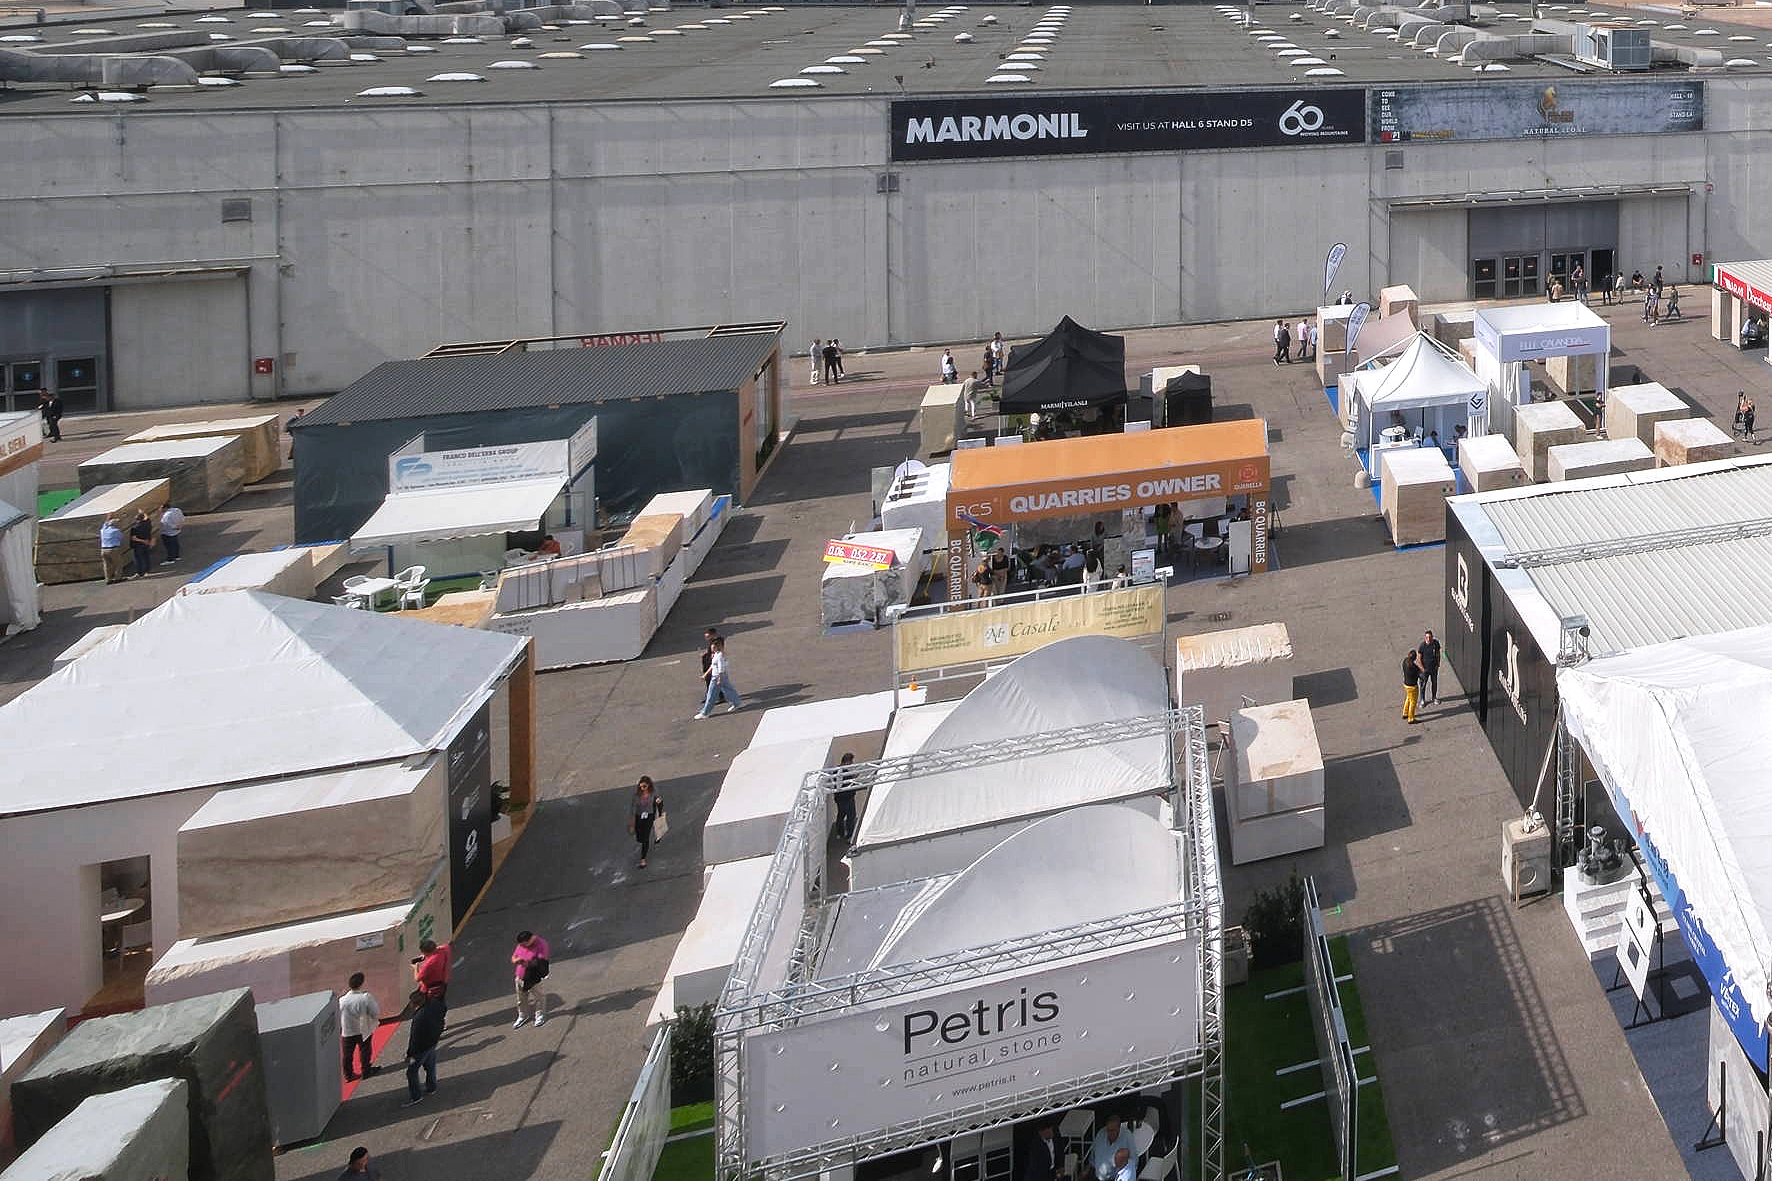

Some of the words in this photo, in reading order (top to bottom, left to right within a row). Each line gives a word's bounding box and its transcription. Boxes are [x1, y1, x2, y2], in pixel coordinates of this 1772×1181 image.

[906, 113, 1088, 144] MARMONIL
[1117, 122, 1141, 131] VISIT
[1143, 121, 1157, 130] US
[1158, 121, 1171, 130] AT
[1172, 120, 1197, 129] HALL
[1198, 120, 1205, 129] 6
[1206, 119, 1238, 128] STAND
[1240, 119, 1253, 127] D5
[1279, 100, 1324, 136] 60
[955, 502, 992, 519] BCS
[1010, 484, 1131, 514] QUARRIES
[1136, 473, 1221, 499] OWNER
[1255, 501, 1265, 514] BC
[950, 539, 962, 554] BC
[1255, 516, 1265, 564] QUARRIES
[1010, 614, 1059, 638] Casale
[904, 987, 1060, 1055] Petris
[904, 1048, 988, 1081] natural
[1000, 1032, 1062, 1058] stone
[952, 1074, 1016, 1097] www.petris.it
